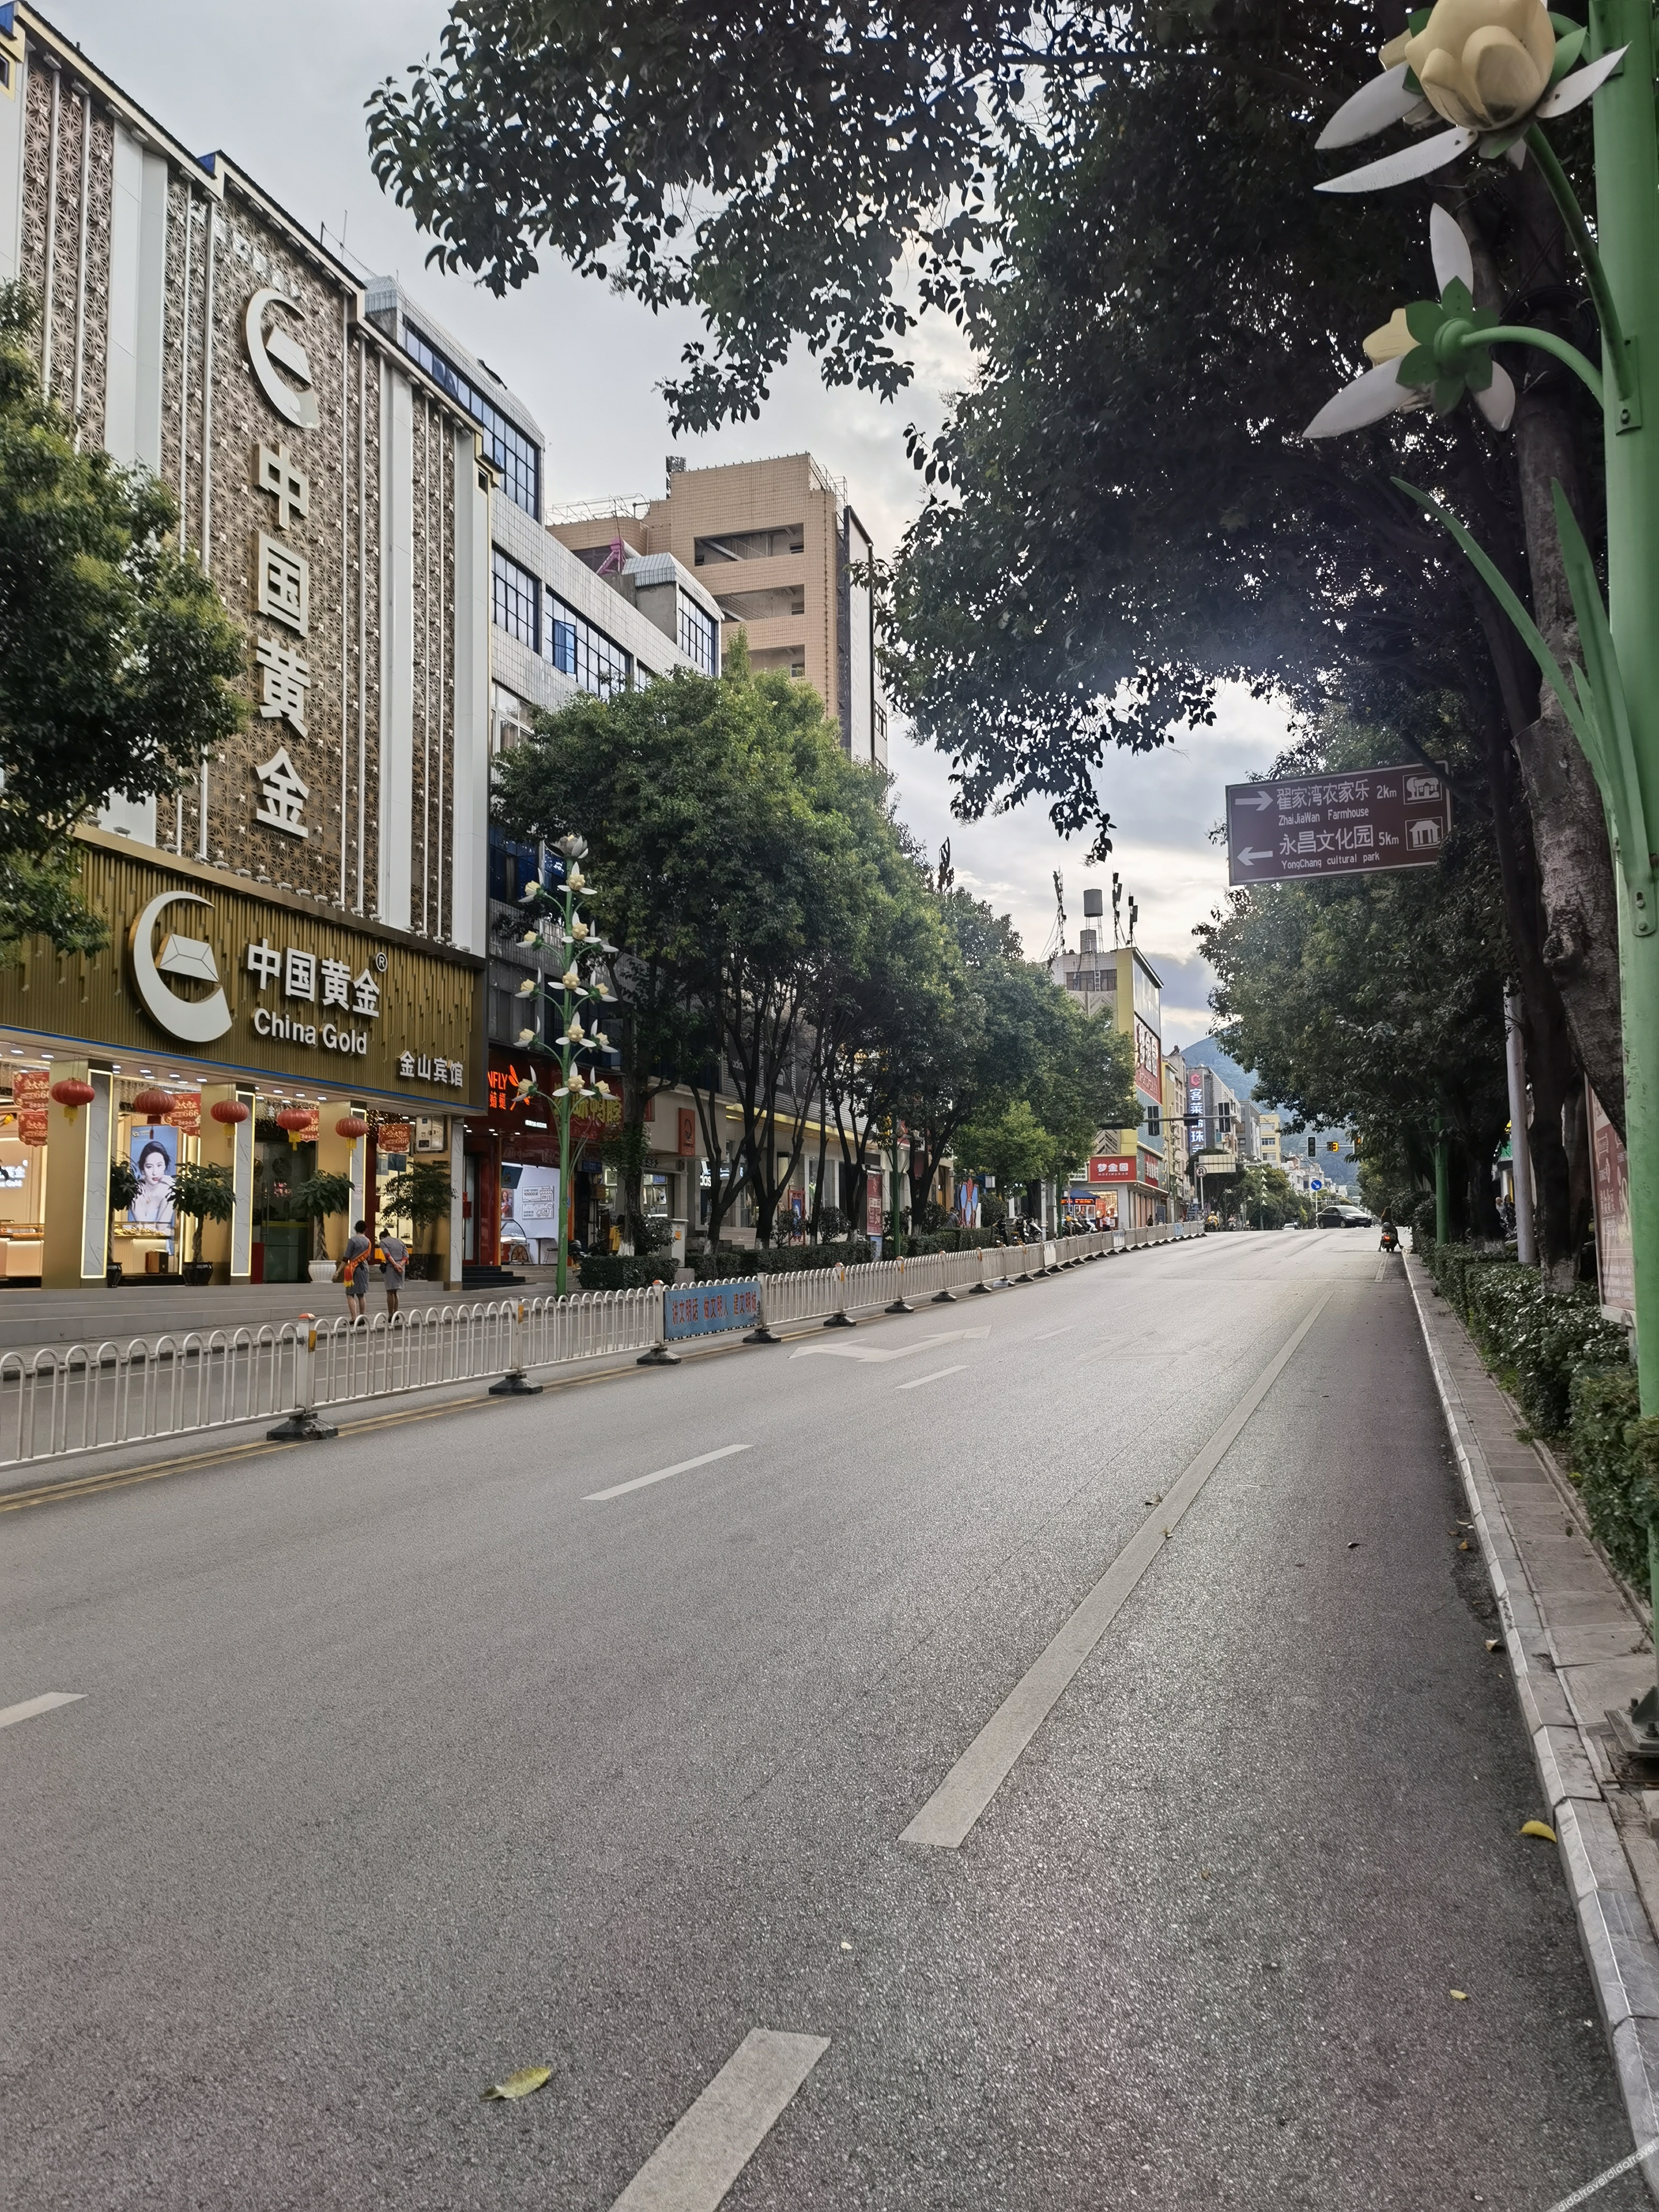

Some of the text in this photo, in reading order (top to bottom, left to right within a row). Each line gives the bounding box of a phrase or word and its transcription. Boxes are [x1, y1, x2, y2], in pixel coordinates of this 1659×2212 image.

[255, 443, 310, 838] 中国黄金
[1276, 779, 1370, 810] 翟家湾农家乐
[1278, 807, 1370, 826] ZhaiJiaWan Farmhouse
[1279, 825, 1373, 855] 永昌文化园
[1282, 852, 1380, 870] YongChang cultural park
[247, 938, 380, 1017] 中国黄金
[253, 1008, 367, 1055] China Gold
[399, 1050, 463, 1088] 金山宾馆
[1097, 1163, 1129, 1172] 梦金园
[672, 1297, 698, 1325] 讲文明话
